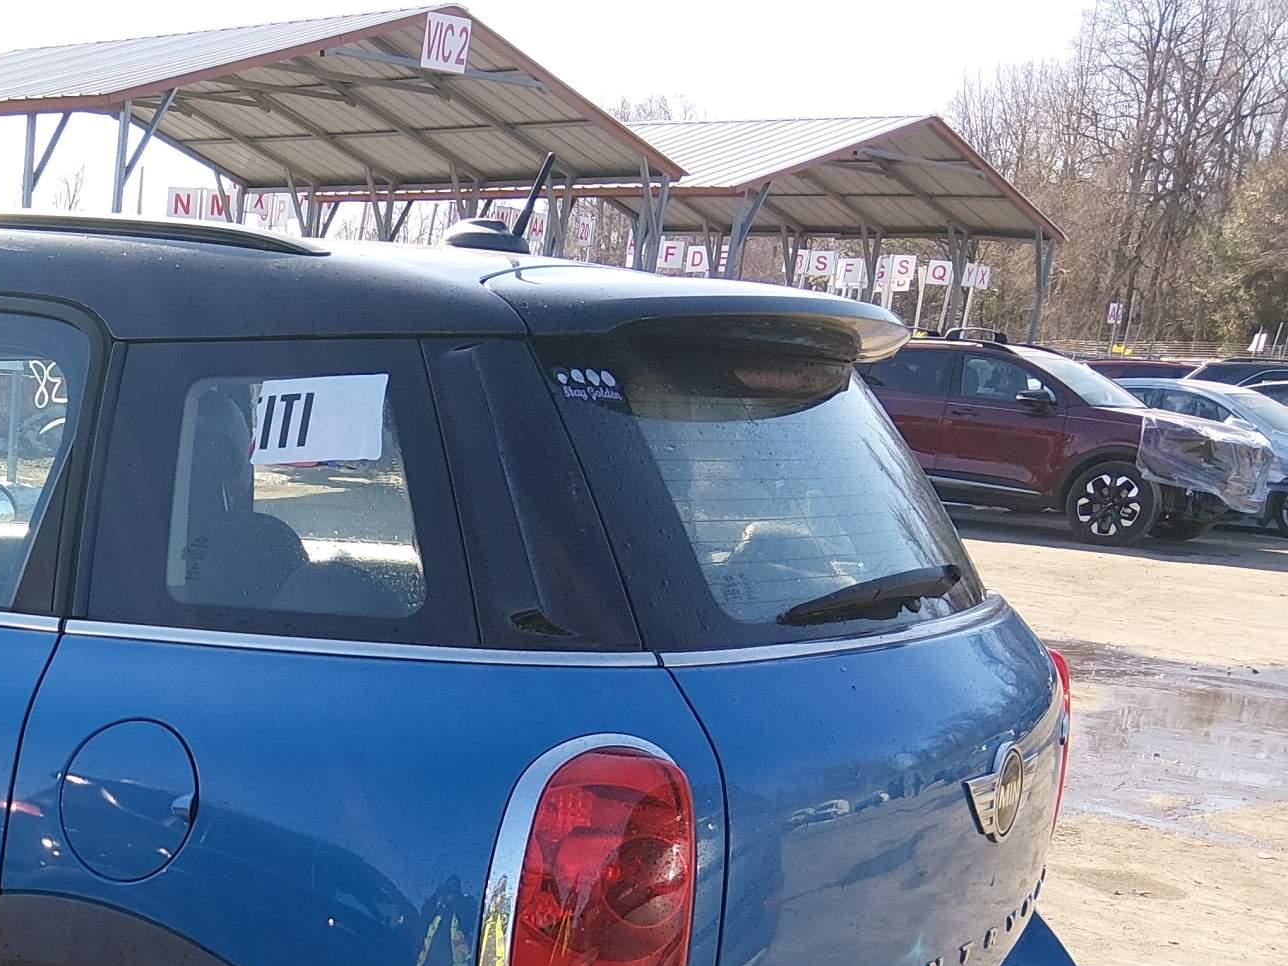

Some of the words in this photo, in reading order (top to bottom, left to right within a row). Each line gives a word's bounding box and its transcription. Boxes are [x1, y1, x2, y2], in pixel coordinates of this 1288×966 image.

[427, 20, 454, 63] VIC
[455, 27, 469, 65] 2
[173, 193, 190, 215] N
[210, 194, 230, 216] M
[664, 246, 677, 263] F
[691, 251, 703, 267] D
[815, 255, 828, 271] S
[898, 260, 909, 275] S
[932, 265, 945, 281] Q
[258, 392, 315, 450] ITI
